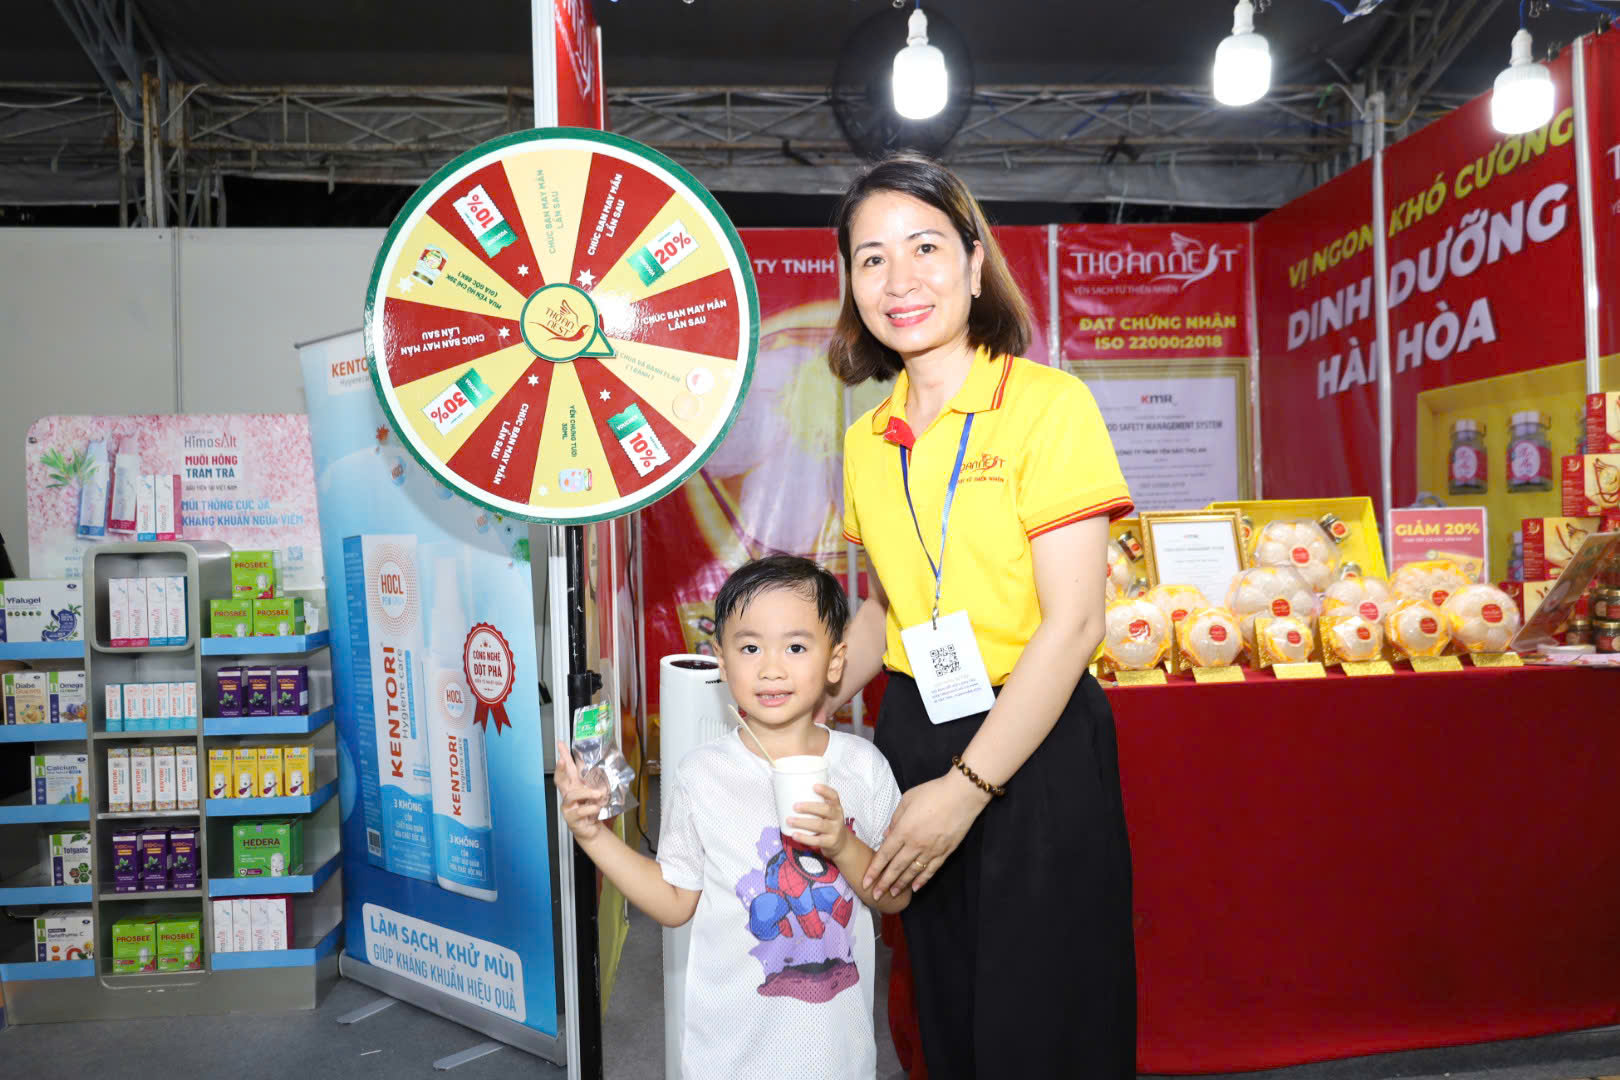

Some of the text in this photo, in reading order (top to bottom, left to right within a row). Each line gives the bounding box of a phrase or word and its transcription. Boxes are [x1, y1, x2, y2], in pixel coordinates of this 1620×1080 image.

[467, 194, 495, 229] 10%
[613, 199, 625, 219] SAU
[588, 232, 602, 256] CHÚC
[603, 194, 615, 214] MAY
[1289, 258, 1308, 289] VỊ
[1312, 224, 1375, 276] NGON
[1388, 172, 1447, 238] KHÓ
[654, 232, 691, 264] 20%
[753, 259, 835, 273] TY TNHH
[1287, 182, 1568, 351] DINH DƯỠNG
[686, 303, 705, 316] MAY
[688, 316, 706, 327] SAU
[1080, 312, 1237, 334] ĐẠT CHỨNG NHẬN
[421, 330, 440, 341] SAU
[1095, 335, 1223, 350] ISO 22000:2018
[1396, 297, 1496, 374] HÒA
[422, 341, 441, 352] MAY
[431, 391, 468, 424] 30%
[515, 403, 529, 427] CHÚC
[1119, 420, 1223, 432] SAFETY MANAGEMENT SYSTEM
[491, 440, 504, 460] SAU
[501, 445, 514, 465] MAY
[629, 432, 657, 468] 10%
[1395, 519, 1480, 536] GIẢM 20%
[234, 561, 269, 570] PROSBEE
[380, 573, 404, 596] HOCL
[214, 610, 247, 618] PROSBEE
[256, 609, 289, 617] PROSBEE
[473, 649, 486, 661] CÔNG
[60, 682, 84, 691] Omega
[446, 689, 463, 704] HOCL
[383, 646, 404, 778] KENTORI
[447, 735, 462, 816] KENTORI
[393, 798, 399, 809] 3
[242, 838, 281, 848] HEDERA
[116, 935, 151, 943] PROSBEE
[160, 932, 195, 941] PROSBEE
[371, 913, 515, 982] LÀM SẠCH, KHỬ MÙI
[373, 943, 394, 966] GIÚP
[396, 951, 428, 979] KHÁNG
[430, 964, 465, 993] KHUẨN
[467, 977, 491, 1006] HIỆU
